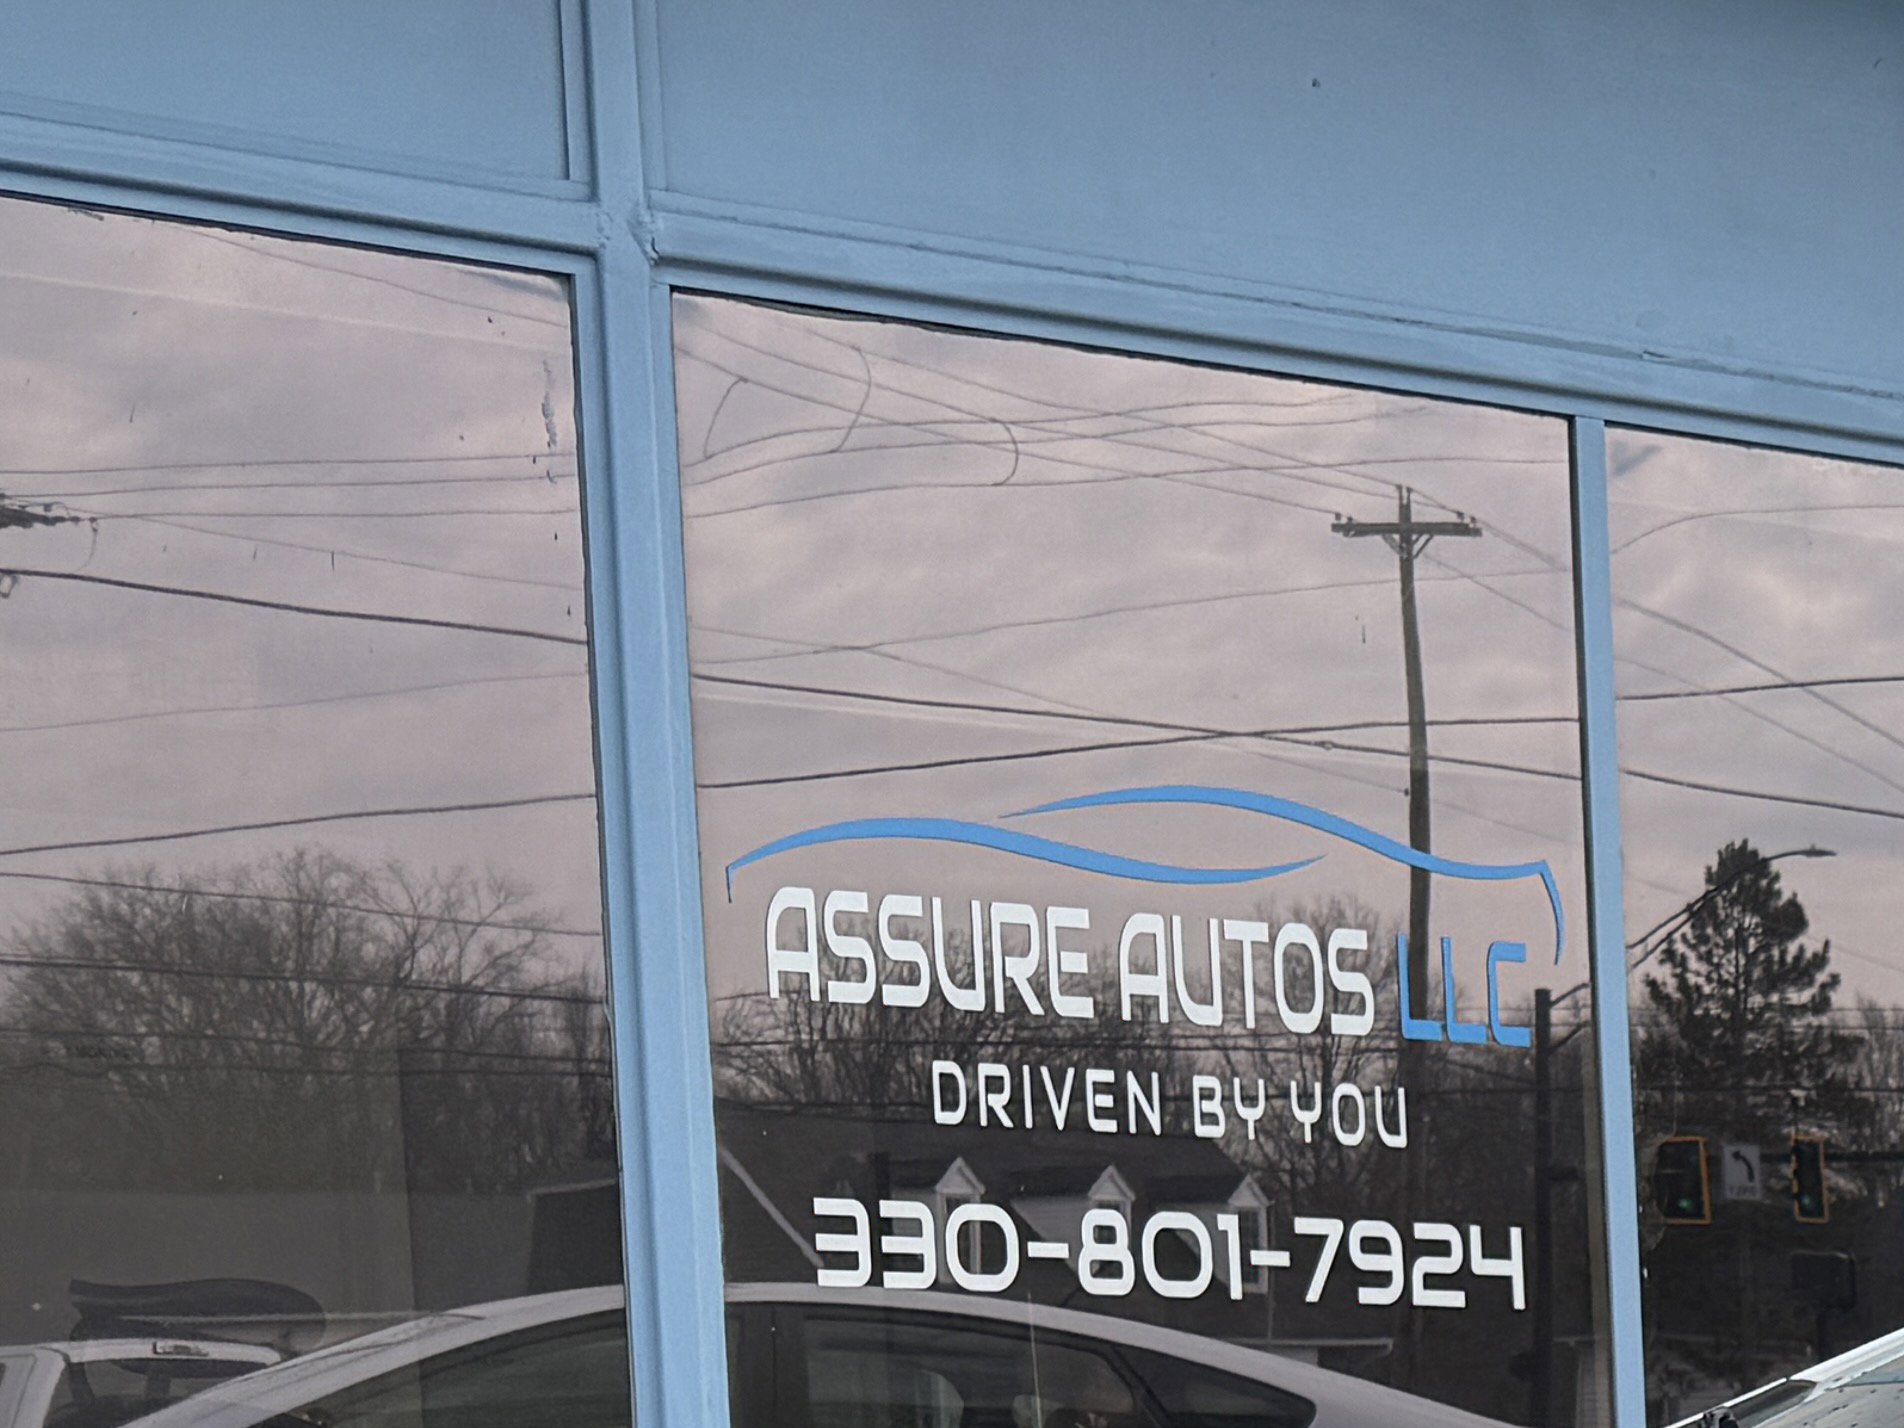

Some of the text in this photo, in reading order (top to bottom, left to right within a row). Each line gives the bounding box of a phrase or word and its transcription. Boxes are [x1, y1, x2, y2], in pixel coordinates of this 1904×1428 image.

[765, 886, 1534, 1048] ASSURE AUTOS LLC
[931, 1060, 1409, 1149] DRIVEN BY YOU
[812, 1196, 1527, 1312] 330-801-7924
